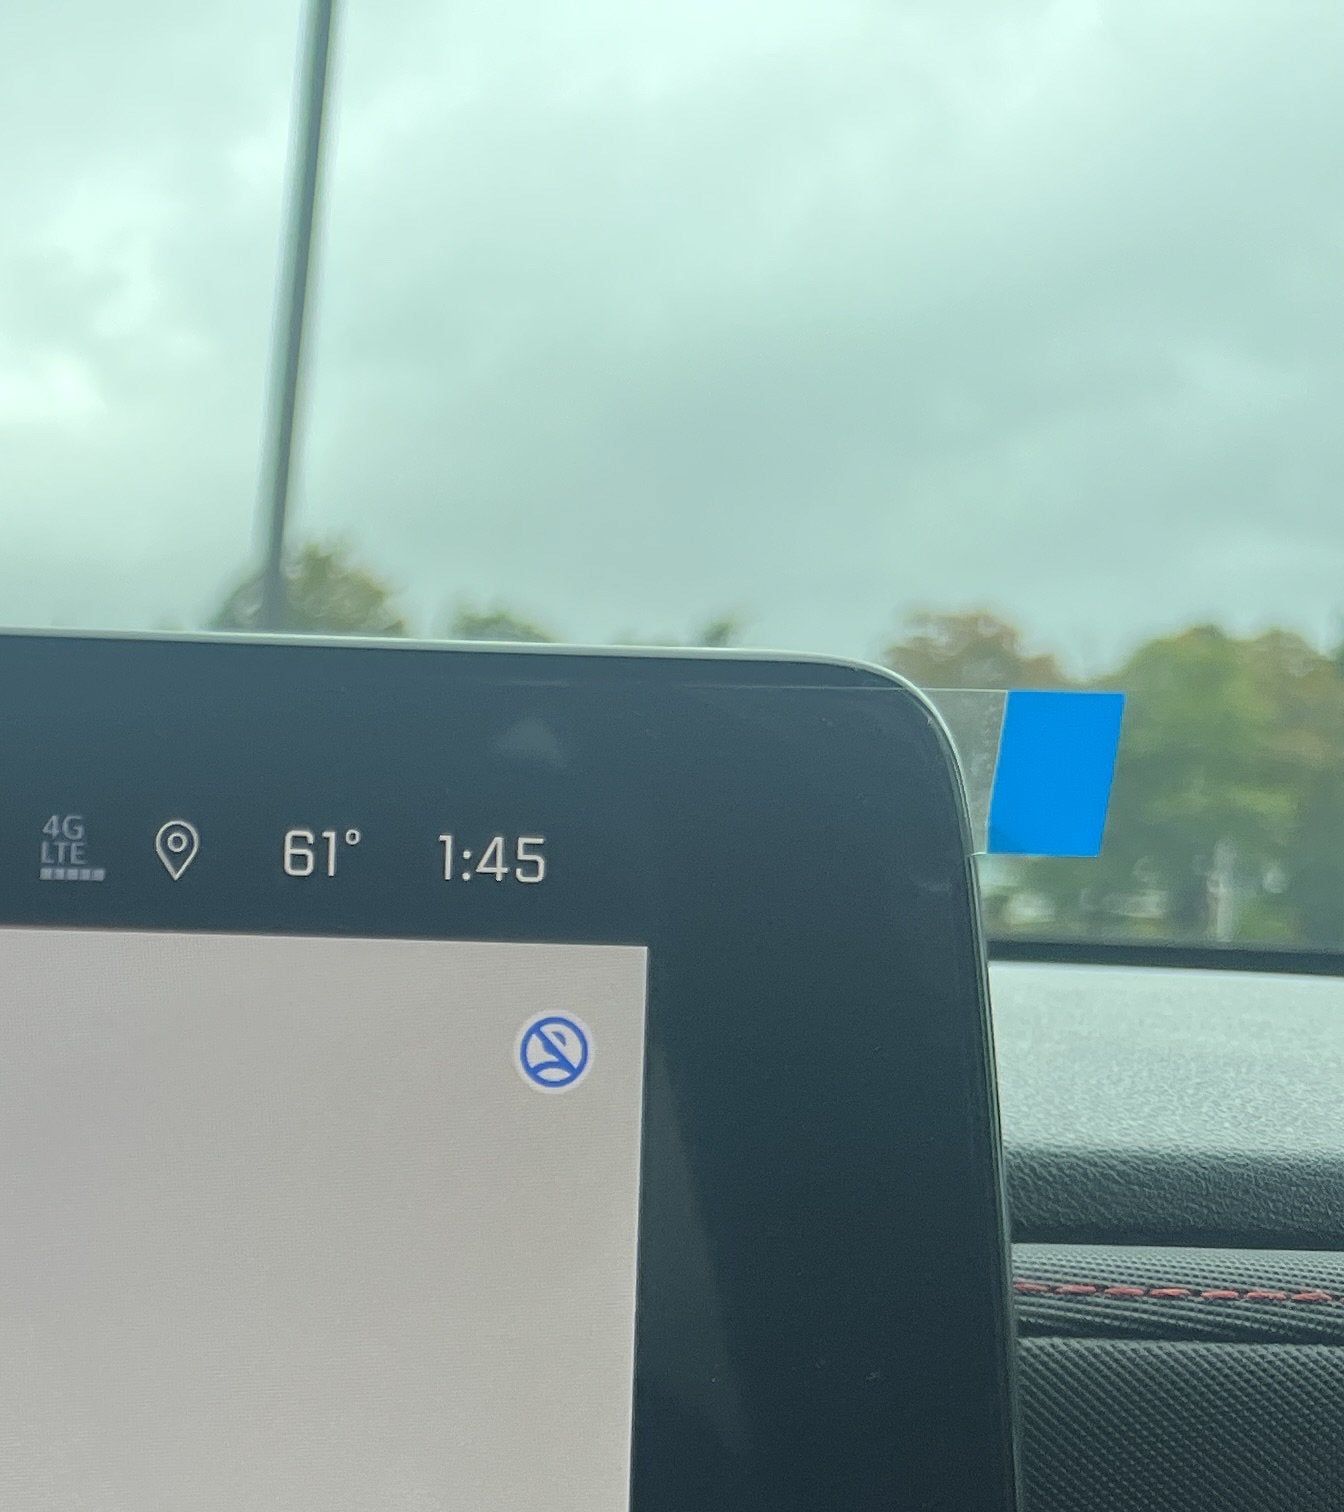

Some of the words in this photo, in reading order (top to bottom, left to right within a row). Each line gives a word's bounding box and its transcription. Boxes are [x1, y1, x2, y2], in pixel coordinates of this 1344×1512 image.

[41, 812, 86, 843] 4G
[40, 841, 87, 867] LTE
[437, 833, 548, 885] 1:45
